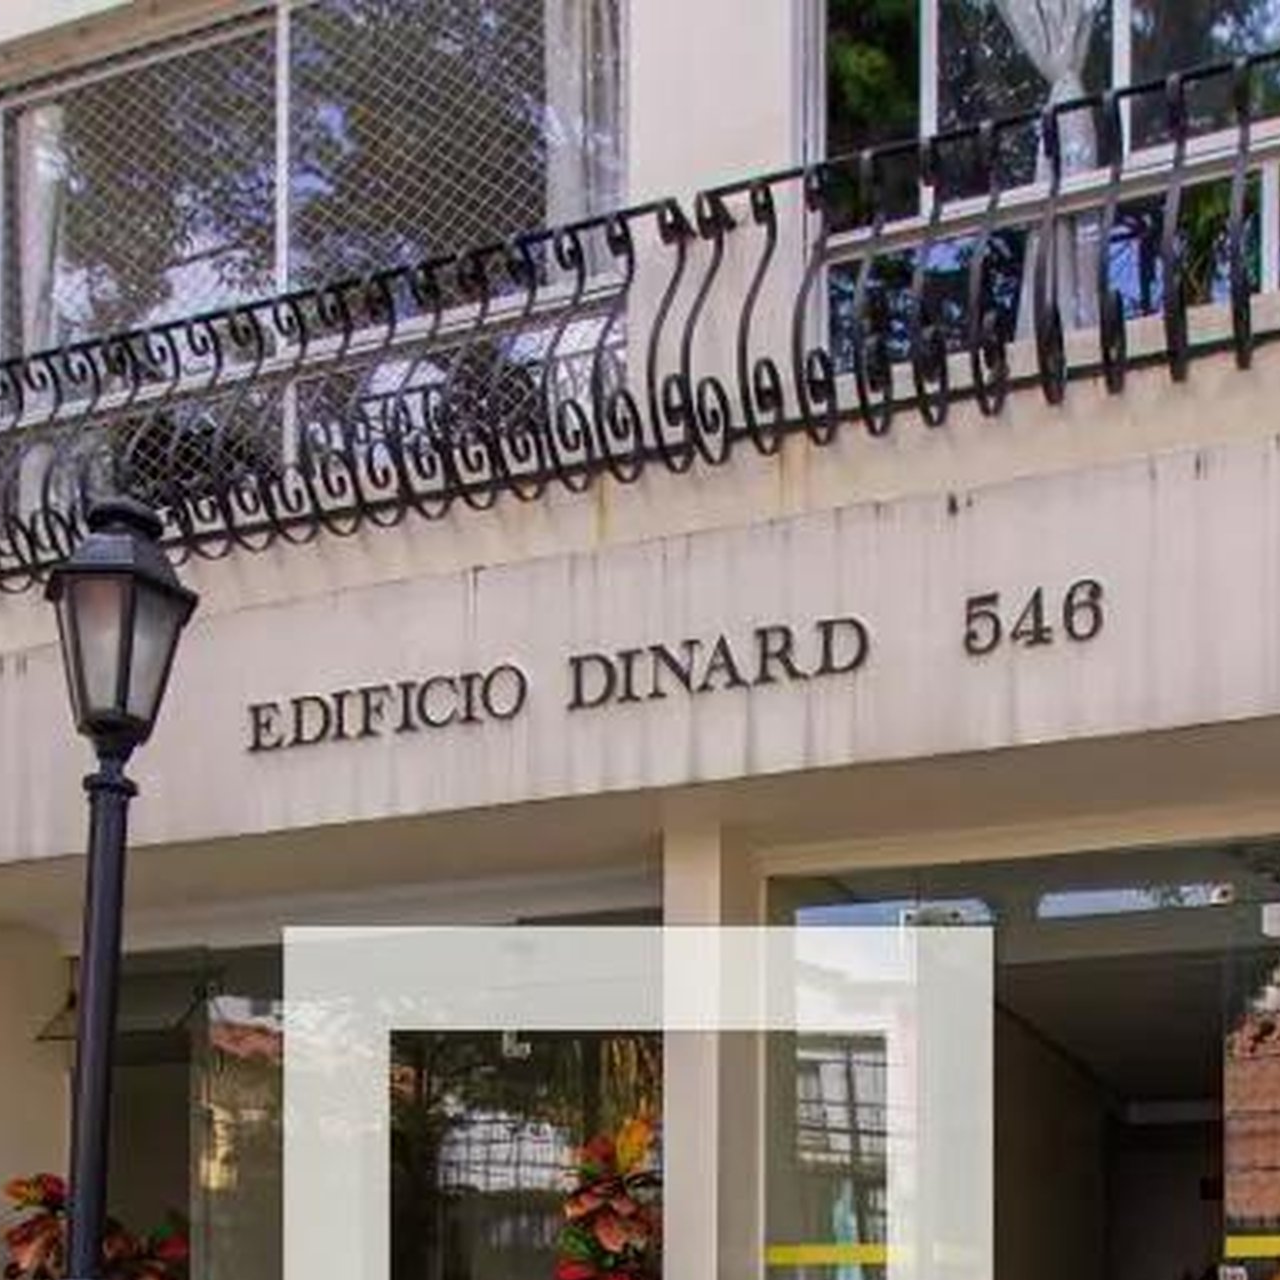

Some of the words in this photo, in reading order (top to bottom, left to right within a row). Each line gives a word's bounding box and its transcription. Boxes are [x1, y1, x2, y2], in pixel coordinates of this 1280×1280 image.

[247, 665, 528, 754] EDIFICIO
[567, 617, 869, 710] DINARD
[963, 579, 1105, 658] 546
